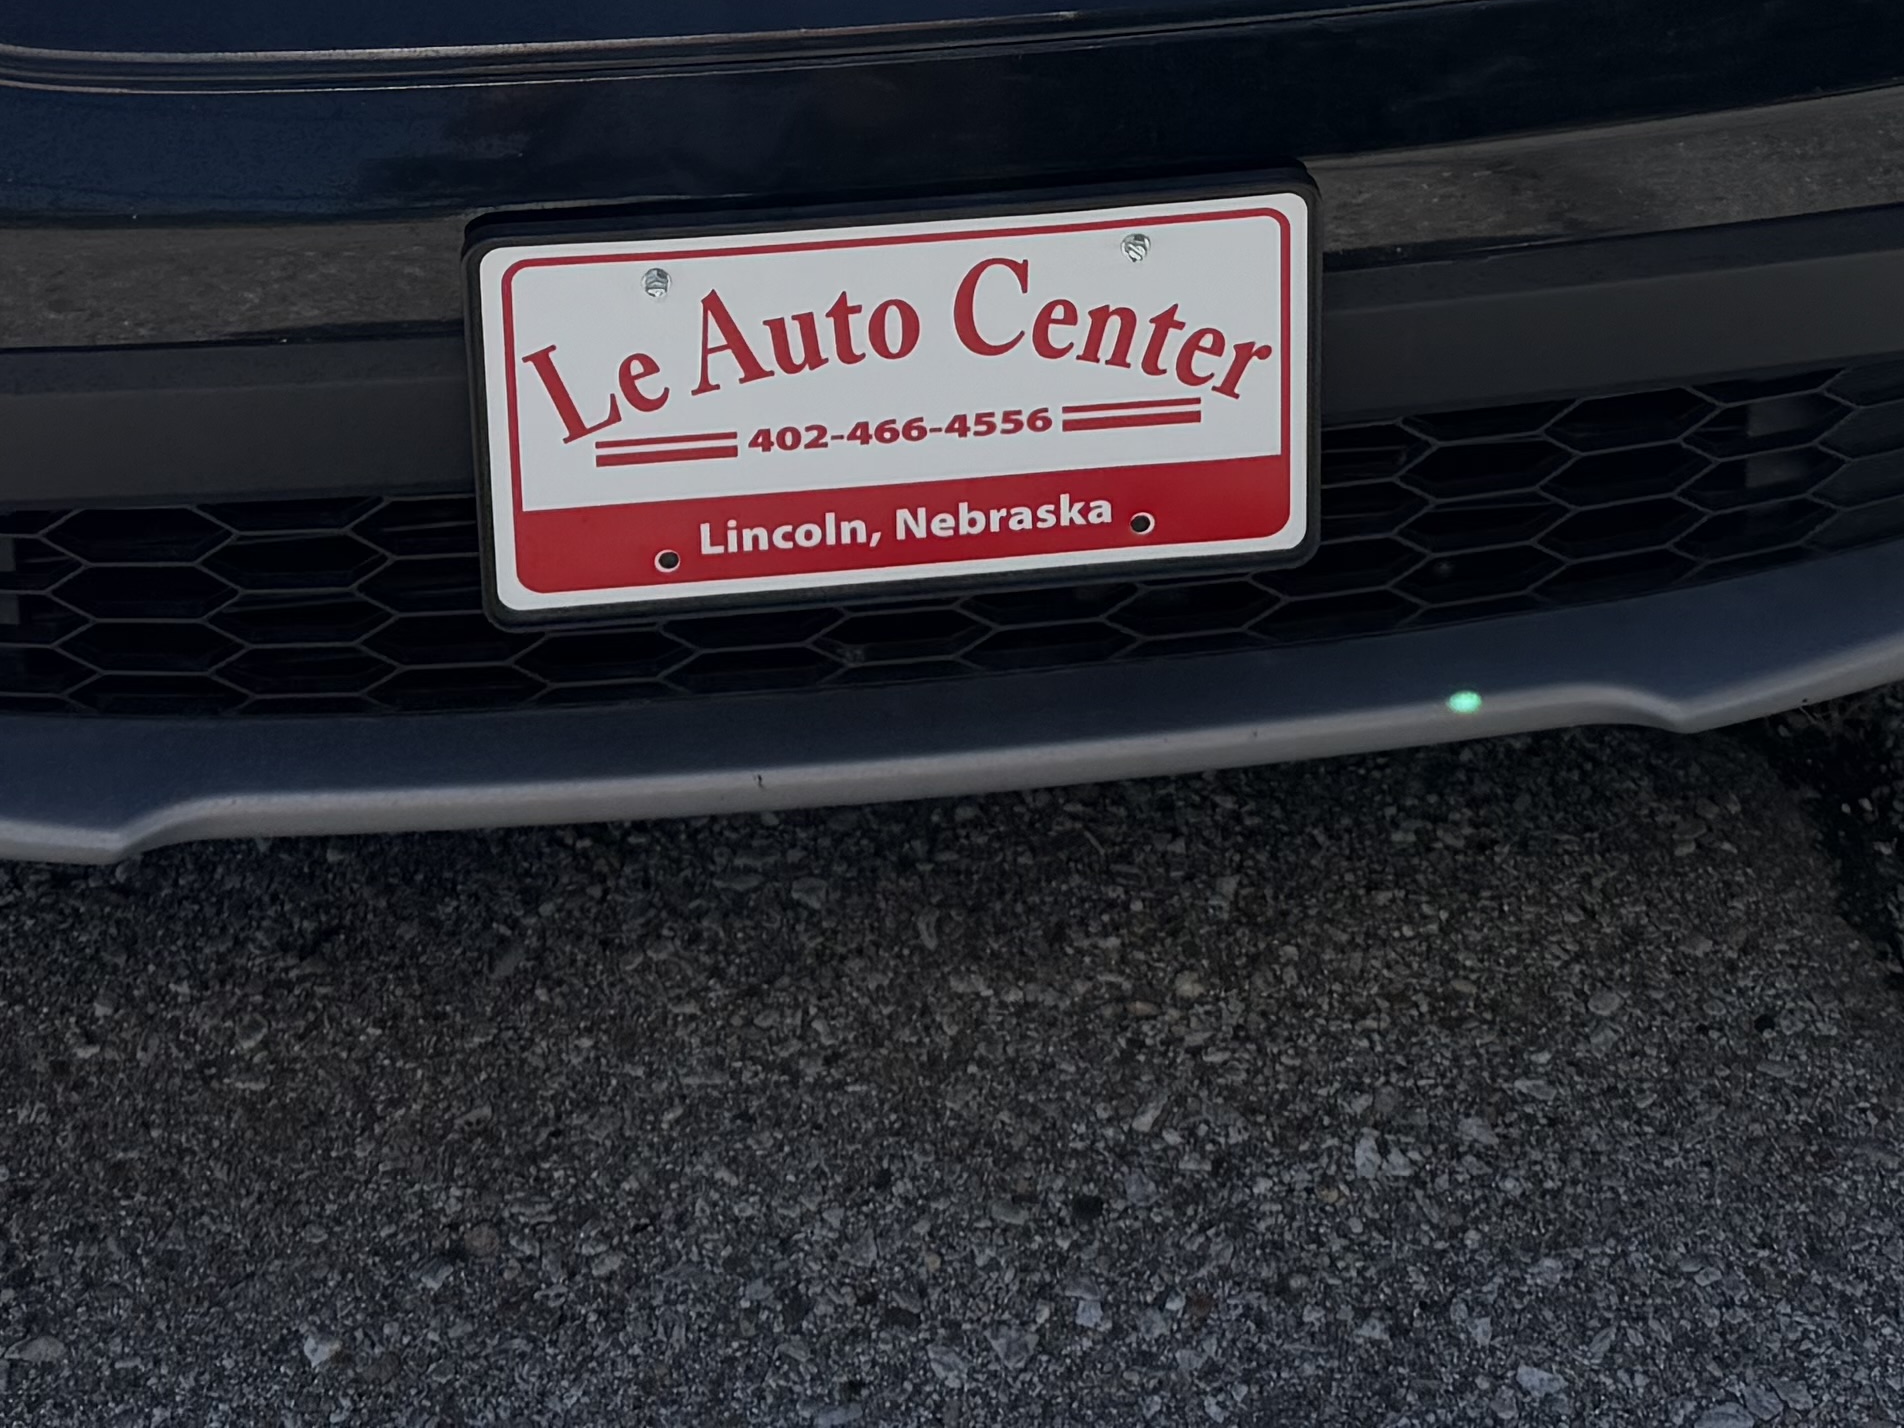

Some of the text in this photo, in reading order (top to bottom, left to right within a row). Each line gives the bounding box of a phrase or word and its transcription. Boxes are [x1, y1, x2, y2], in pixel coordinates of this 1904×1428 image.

[522, 256, 1273, 444] Le Auto Center
[747, 406, 1053, 454] 402-466-4556
[699, 492, 1113, 556] Lincoln, Nebraska
